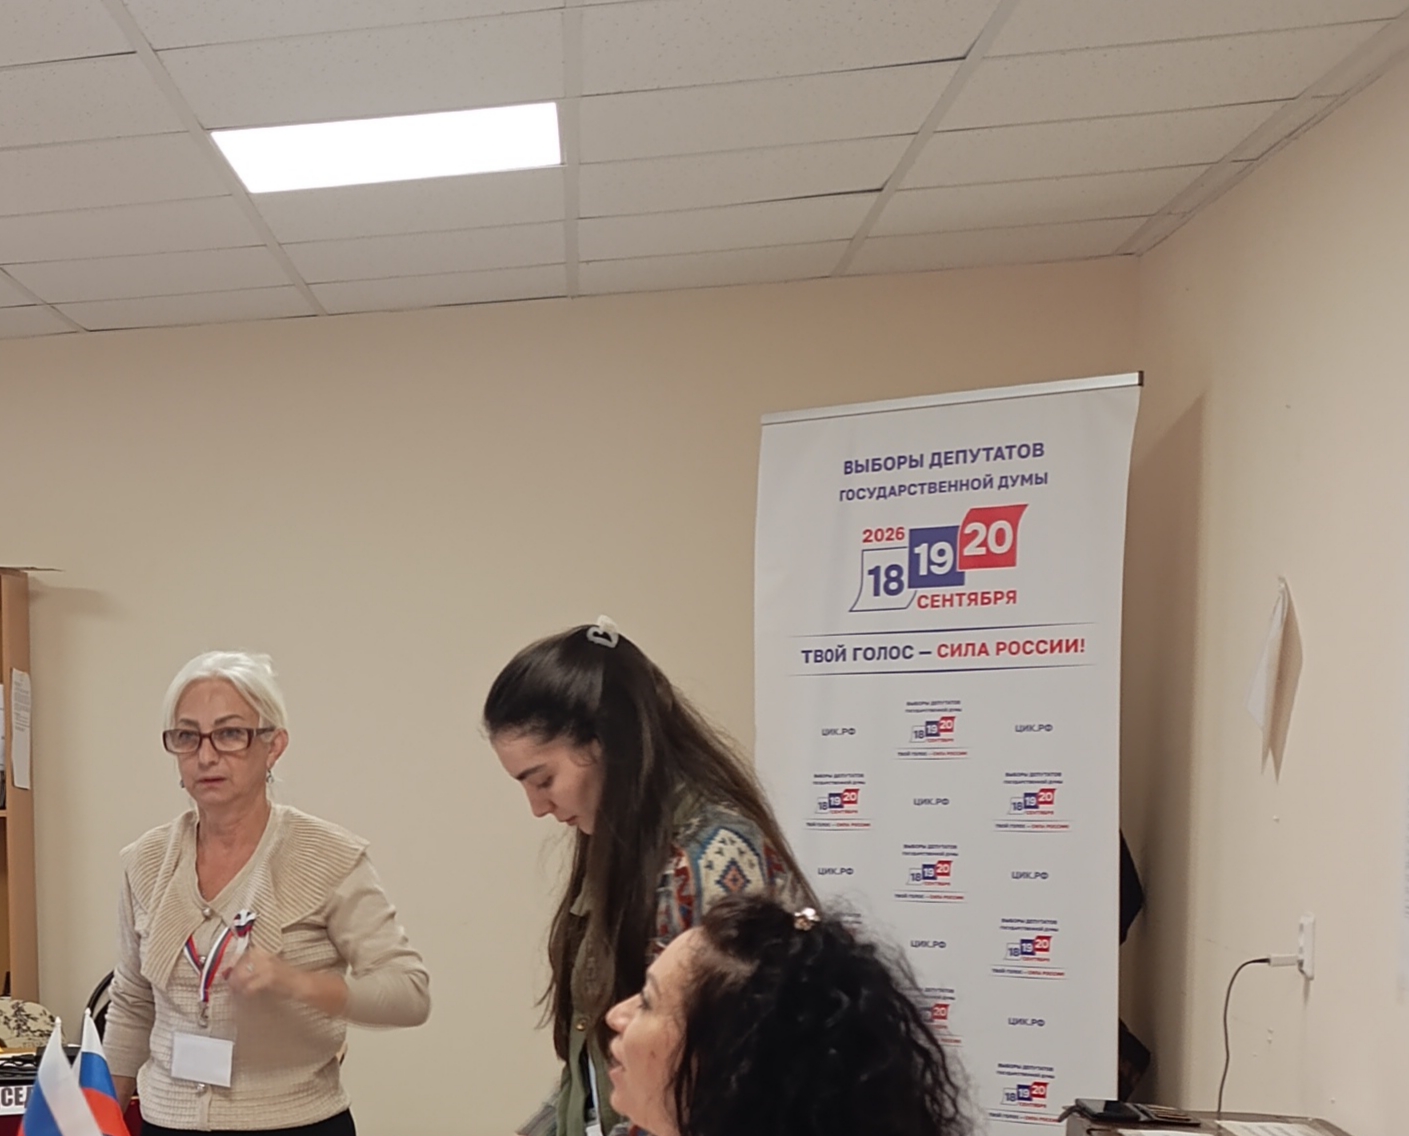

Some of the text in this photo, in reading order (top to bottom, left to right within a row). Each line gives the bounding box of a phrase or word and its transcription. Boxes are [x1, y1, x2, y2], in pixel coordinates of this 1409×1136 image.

[843, 442, 1046, 475] ВЫБОРЫ ДЕПУТАТОВ
[839, 472, 1049, 502] ГОСУДАРСТВЕННОЙ ДУМЫ
[862, 527, 906, 543] 2026
[867, 519, 1014, 597] 18 19 20
[916, 590, 1018, 610] СЕНТЯБРЯ
[801, 644, 847, 663] ТВОЙ
[852, 645, 915, 662] ГОЛОС
[936, 641, 990, 658] СИЛА
[995, 638, 1086, 656] РОССИИ!
